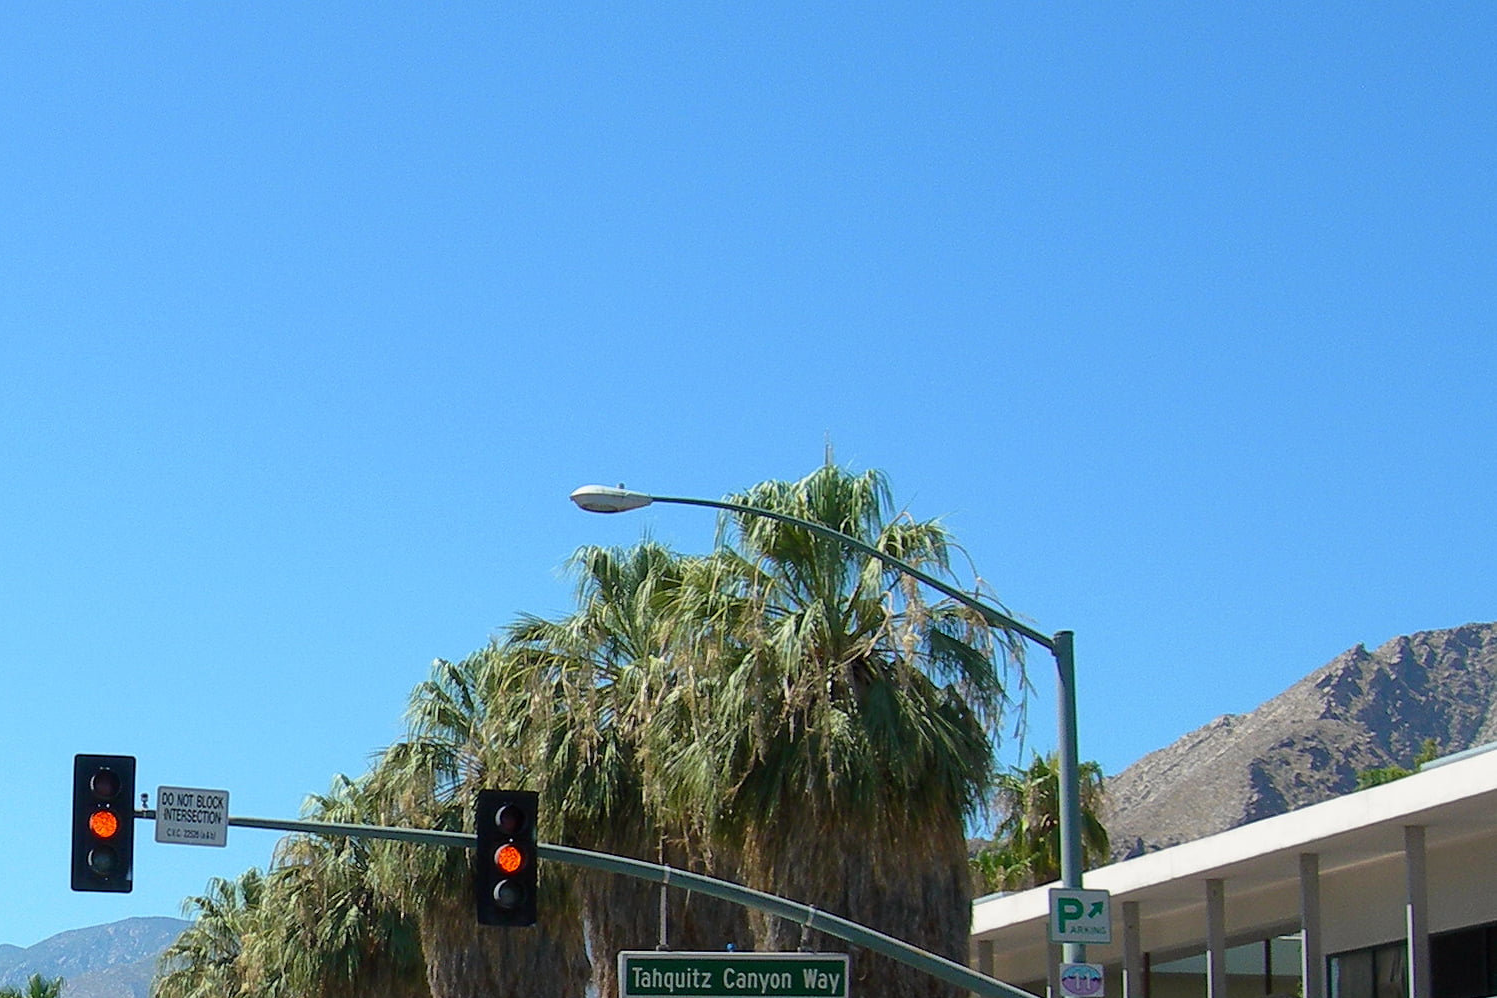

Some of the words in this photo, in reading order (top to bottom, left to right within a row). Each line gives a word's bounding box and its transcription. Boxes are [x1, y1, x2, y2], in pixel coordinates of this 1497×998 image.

[162, 792, 174, 806] DO
[178, 793, 194, 807] NOT
[196, 794, 224, 809] BLOCK
[164, 808, 221, 824] INTERSECTION
[632, 967, 712, 993] Tahquitz
[723, 968, 792, 994] Canyon
[803, 968, 840, 994] Way
